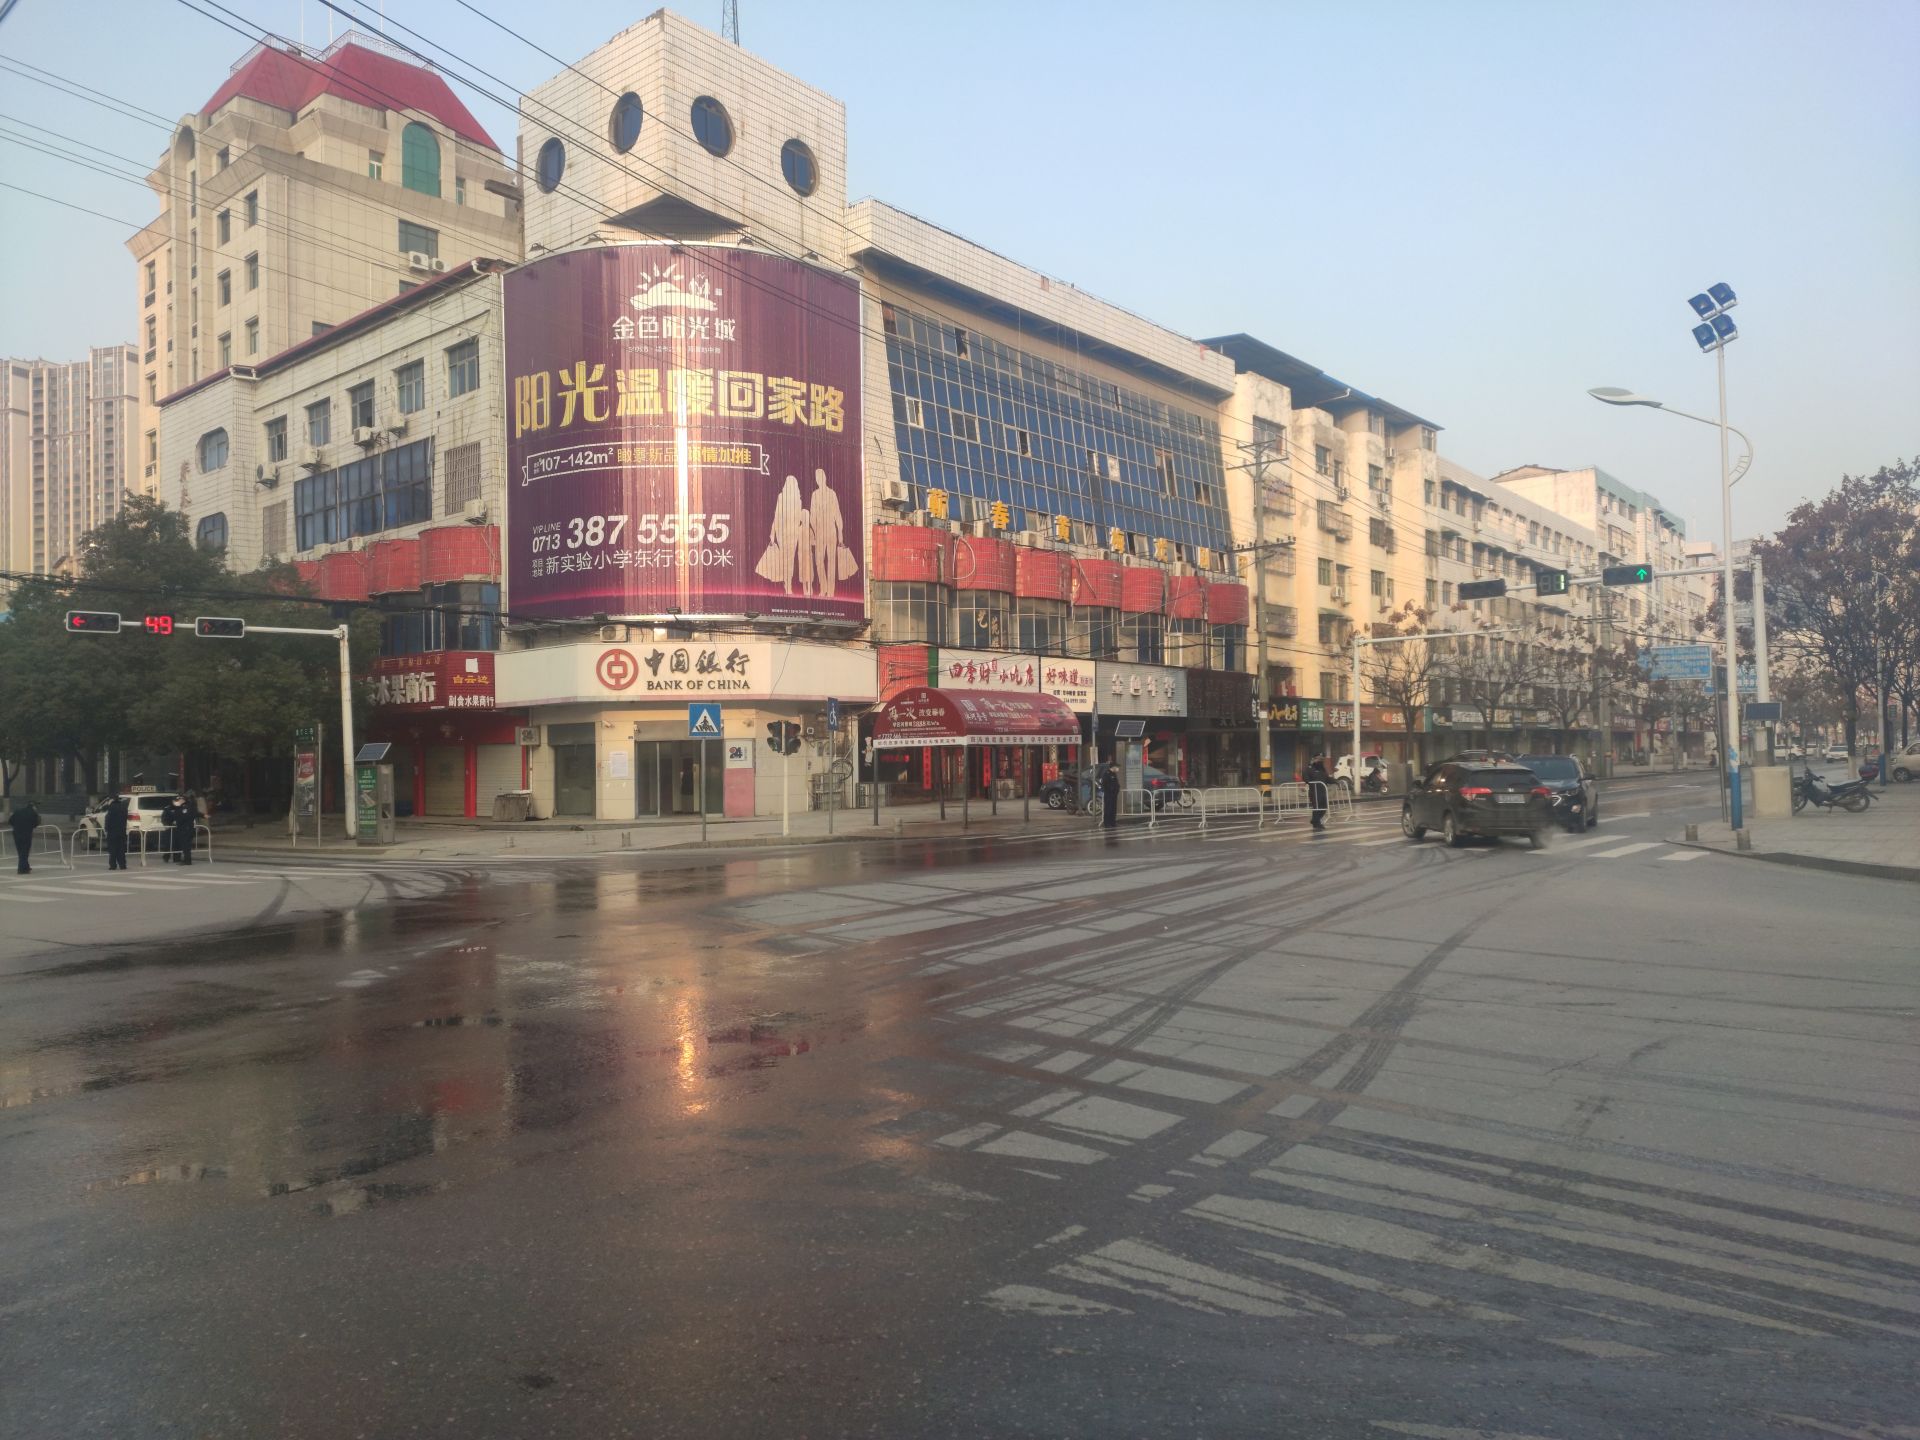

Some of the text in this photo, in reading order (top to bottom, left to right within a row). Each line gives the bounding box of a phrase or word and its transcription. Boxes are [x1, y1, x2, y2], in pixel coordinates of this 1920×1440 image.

[612, 315, 736, 342] 金色阳光城
[514, 361, 845, 438] 阳光温暖回家路
[532, 513, 730, 553] 0713 387 5555
[546, 547, 734, 575] 新实验小学东行300米
[145, 615, 172, 635] 49
[645, 648, 750, 677] 中国银行
[453, 674, 489, 685] 白云边
[647, 680, 750, 691] BANK OF CHINA
[1046, 667, 1078, 686] 好味道
[448, 695, 495, 708] 副食水果商行
